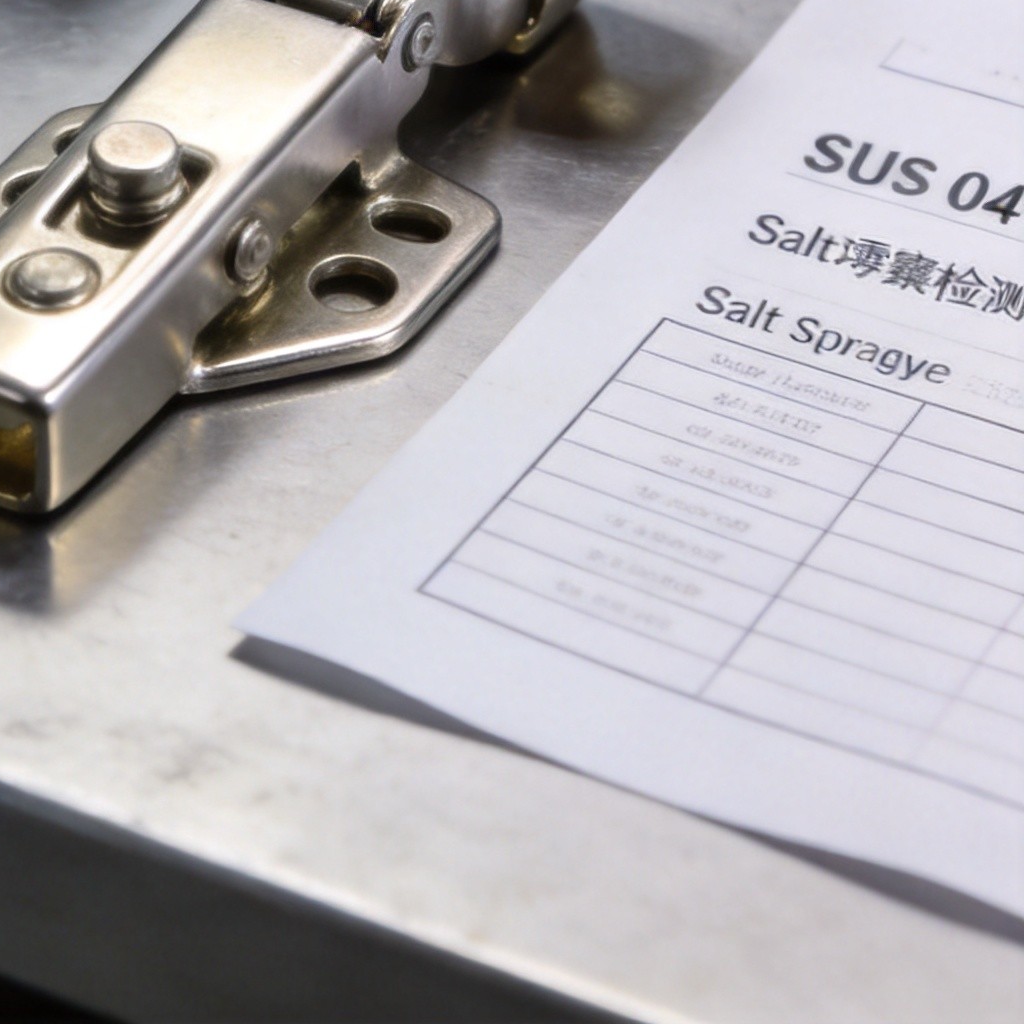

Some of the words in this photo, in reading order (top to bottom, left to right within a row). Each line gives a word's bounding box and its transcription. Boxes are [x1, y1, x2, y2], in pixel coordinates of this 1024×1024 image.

[803, 133, 938, 197] SUS
[947, 171, 1024, 225] 04
[695, 285, 783, 334] Salt
[789, 316, 952, 385] Spragye
